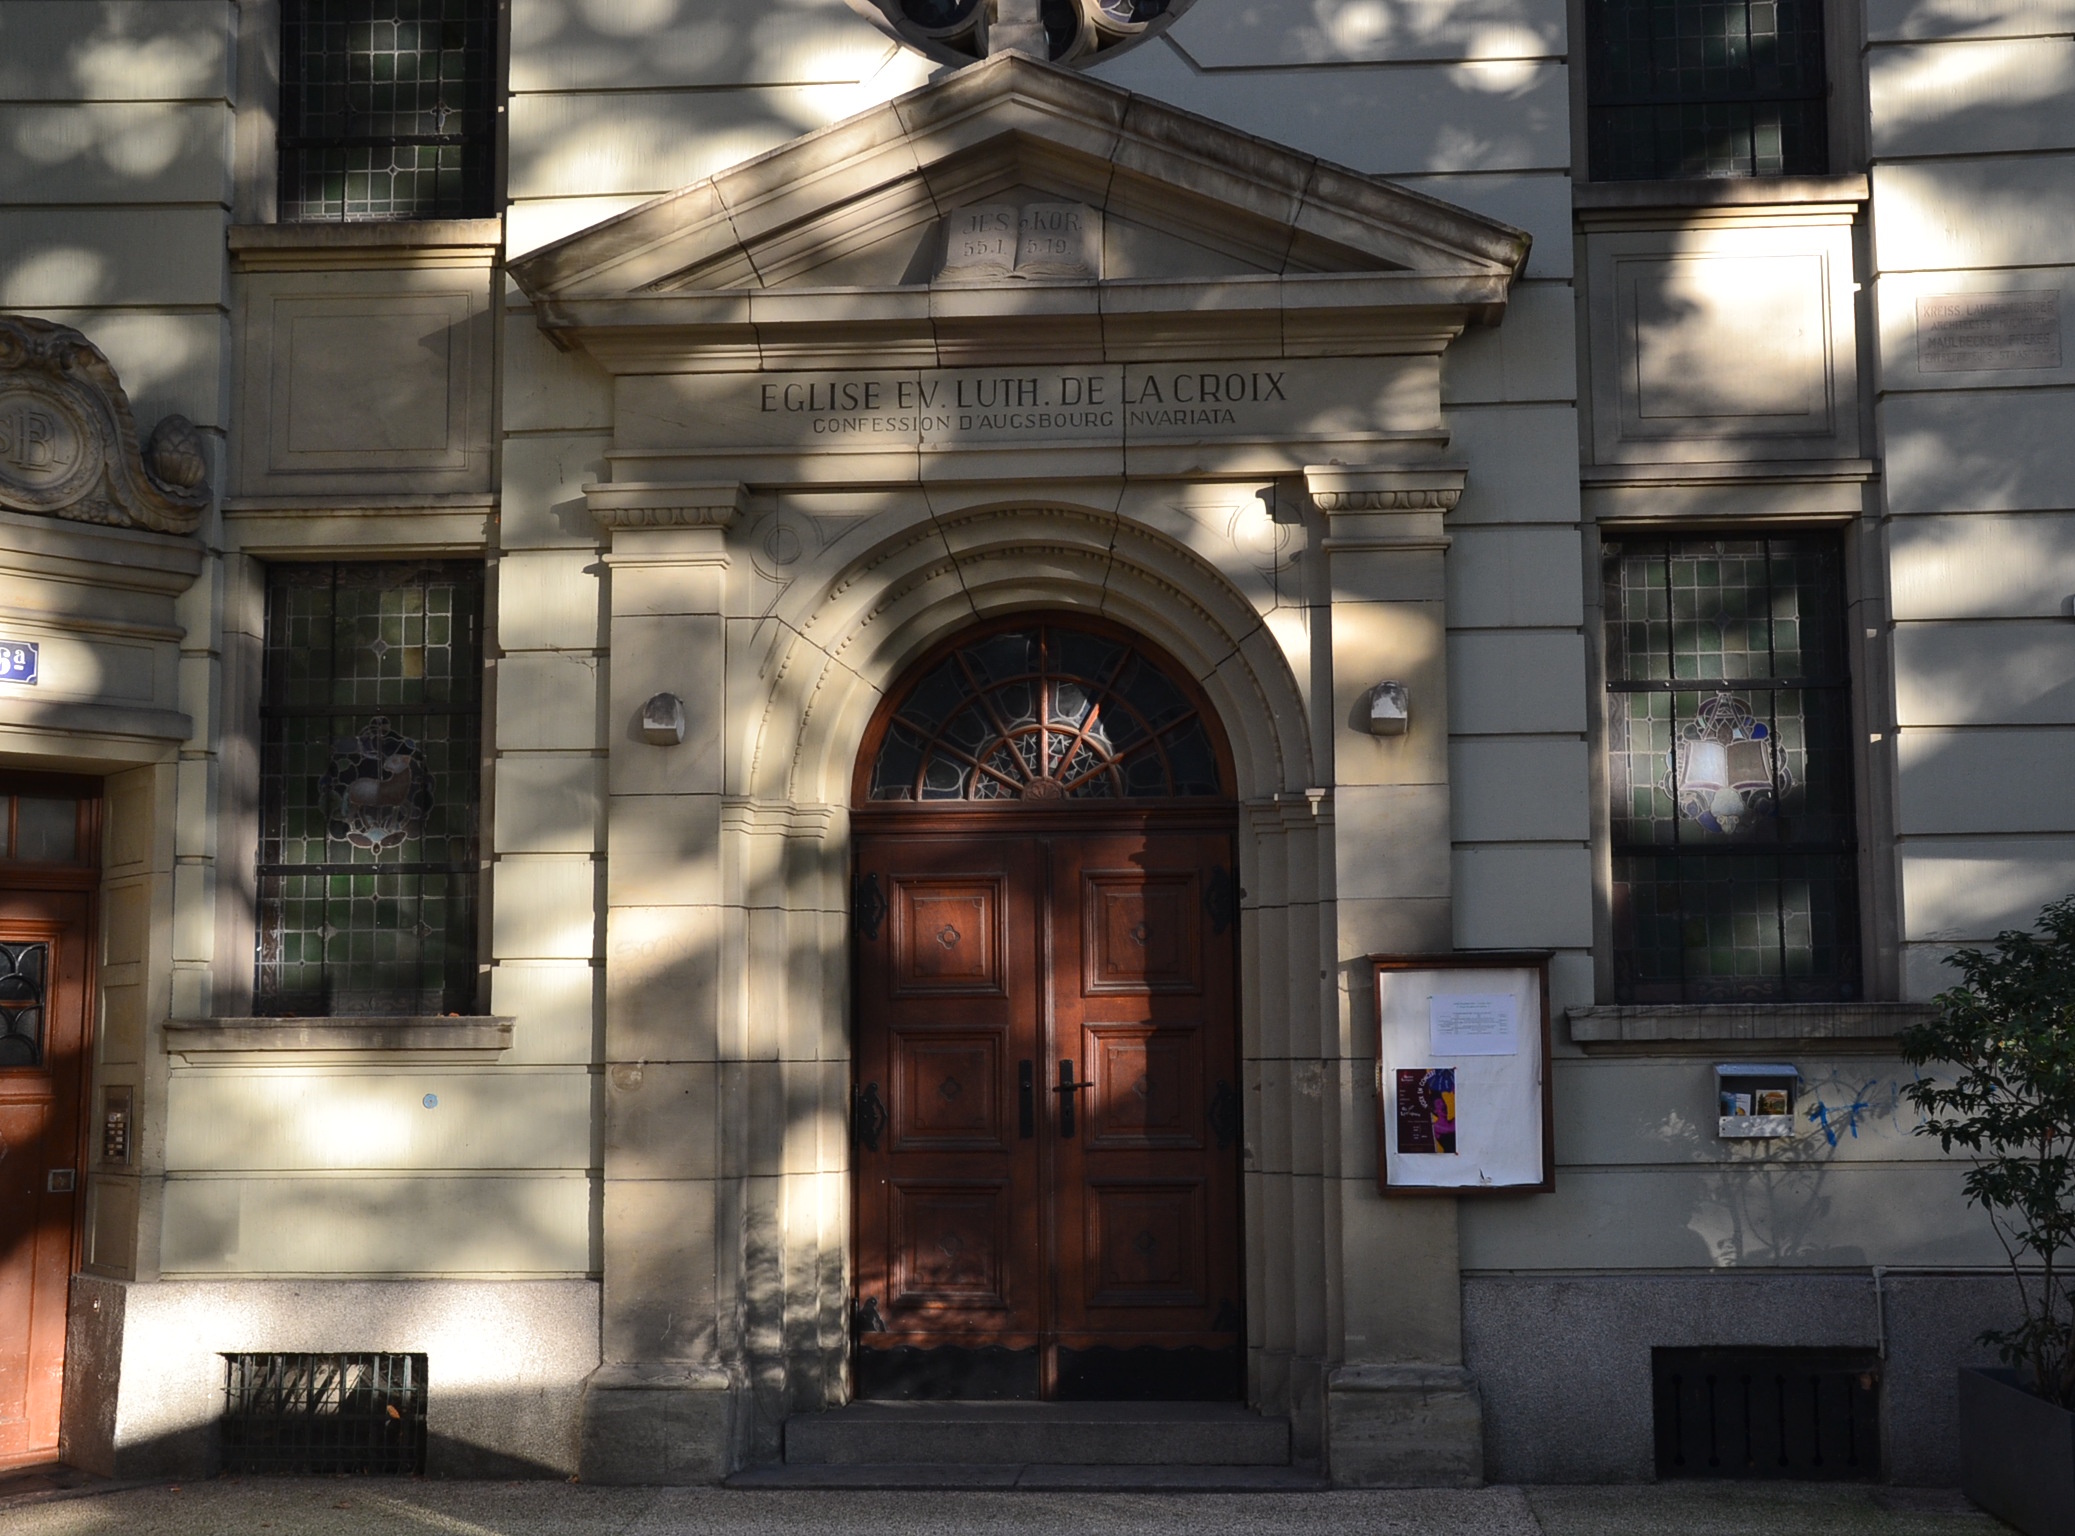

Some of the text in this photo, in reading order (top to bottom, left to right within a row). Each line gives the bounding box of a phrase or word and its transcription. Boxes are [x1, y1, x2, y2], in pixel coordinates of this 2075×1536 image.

[761, 382, 880, 412] EGLISE
[956, 378, 1050, 408] LUTH.
[1060, 376, 1106, 406] DE
[1174, 372, 1287, 402] CROIX
[813, 415, 950, 433] CONFESSION
[959, 411, 1114, 430] D'AUGSBOURG
